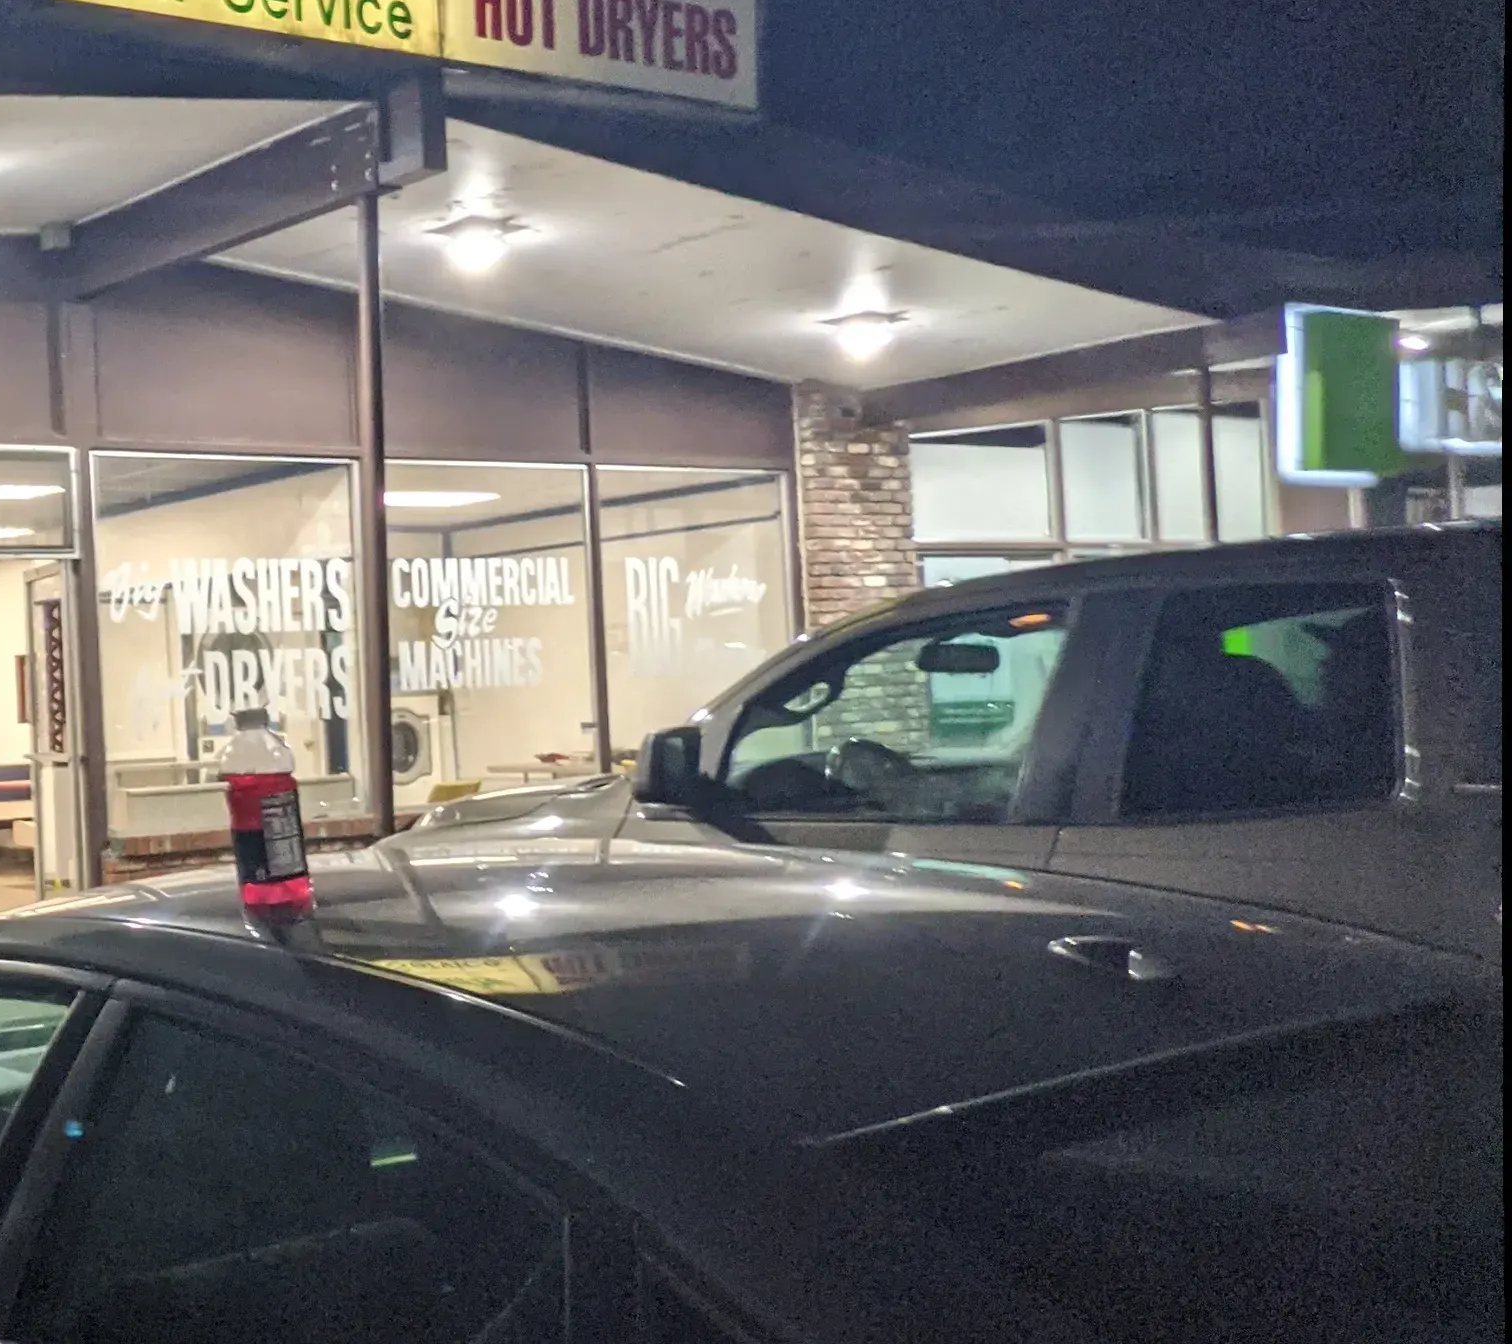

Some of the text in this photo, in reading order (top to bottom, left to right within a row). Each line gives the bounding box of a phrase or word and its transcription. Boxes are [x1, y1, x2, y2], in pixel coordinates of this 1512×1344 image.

[172, 557, 353, 635] WASHERS
[391, 556, 575, 609] COMMERCIAL
[431, 595, 498, 651] Size
[202, 645, 351, 724] DRYERS
[397, 636, 544, 692] MACHINES
